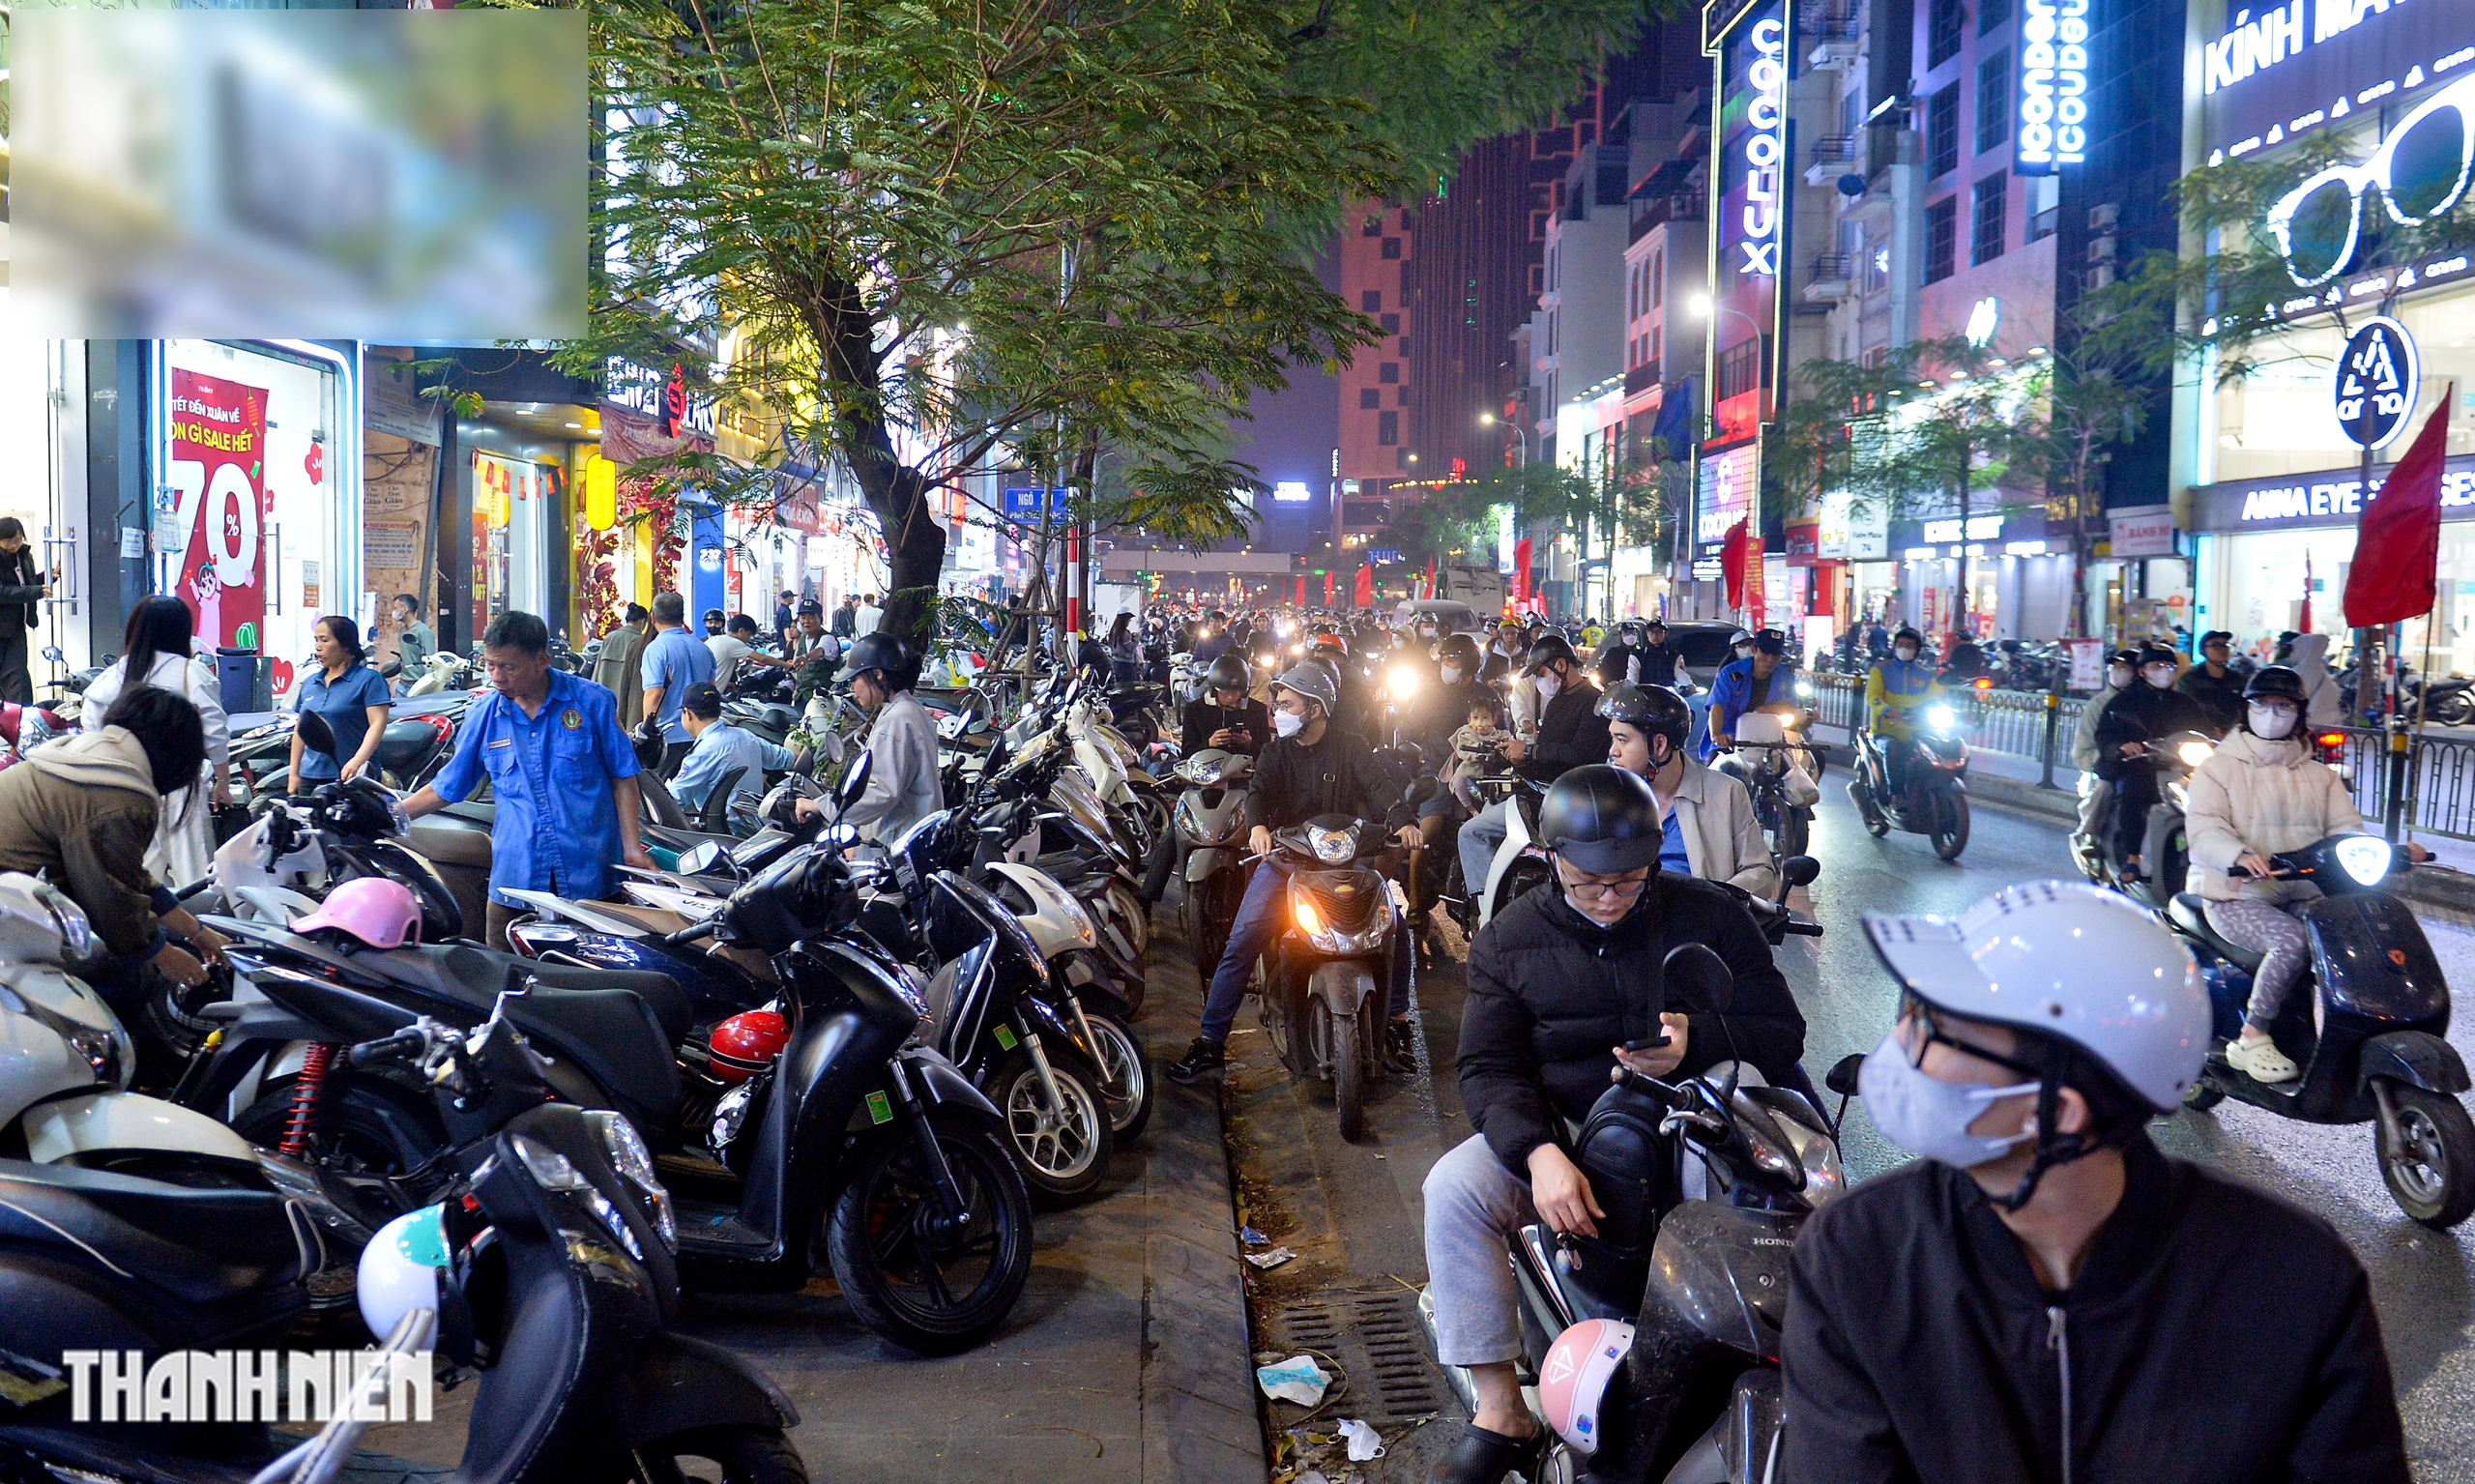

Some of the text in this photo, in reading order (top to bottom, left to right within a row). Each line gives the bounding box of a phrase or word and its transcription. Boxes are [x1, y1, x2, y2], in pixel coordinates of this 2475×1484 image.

[2204, 0, 2304, 96] KÍNH
[2289, 109, 2324, 131] anna
[2357, 80, 2396, 104] anna
[2433, 46, 2475, 73] anna
[1739, 18, 1783, 275] COCOLUX
[2425, 256, 2468, 278] anna
[203, 427, 231, 451] SALE
[232, 427, 253, 452] HẾT
[2241, 485, 2310, 521] ANNA
[1753, 1237, 1794, 1247] HOND
